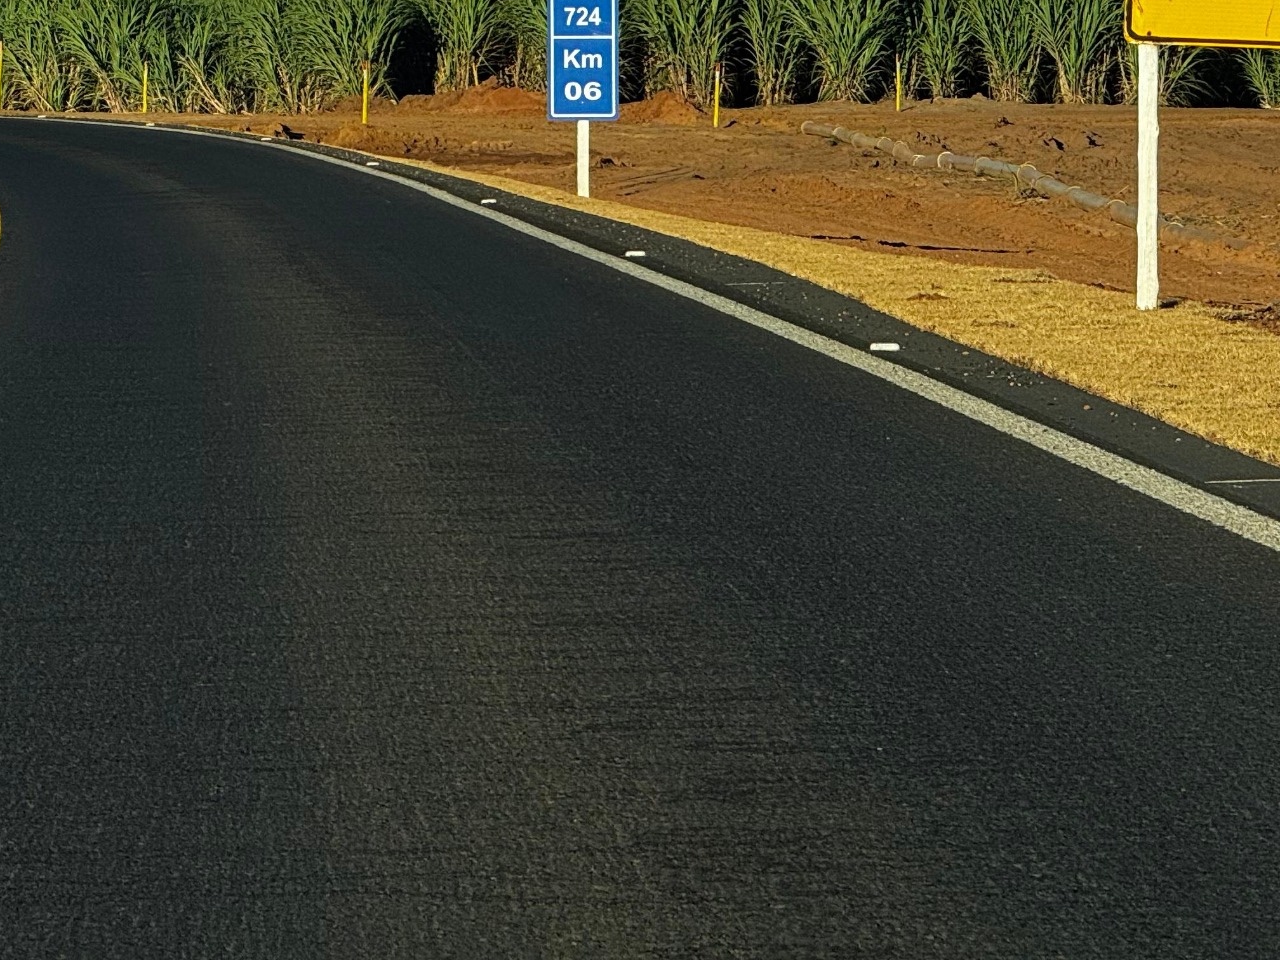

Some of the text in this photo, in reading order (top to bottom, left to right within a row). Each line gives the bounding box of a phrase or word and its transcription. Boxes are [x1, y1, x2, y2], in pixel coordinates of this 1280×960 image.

[563, 7, 602, 26] 724
[563, 49, 603, 69] Km
[564, 81, 602, 101] 06
